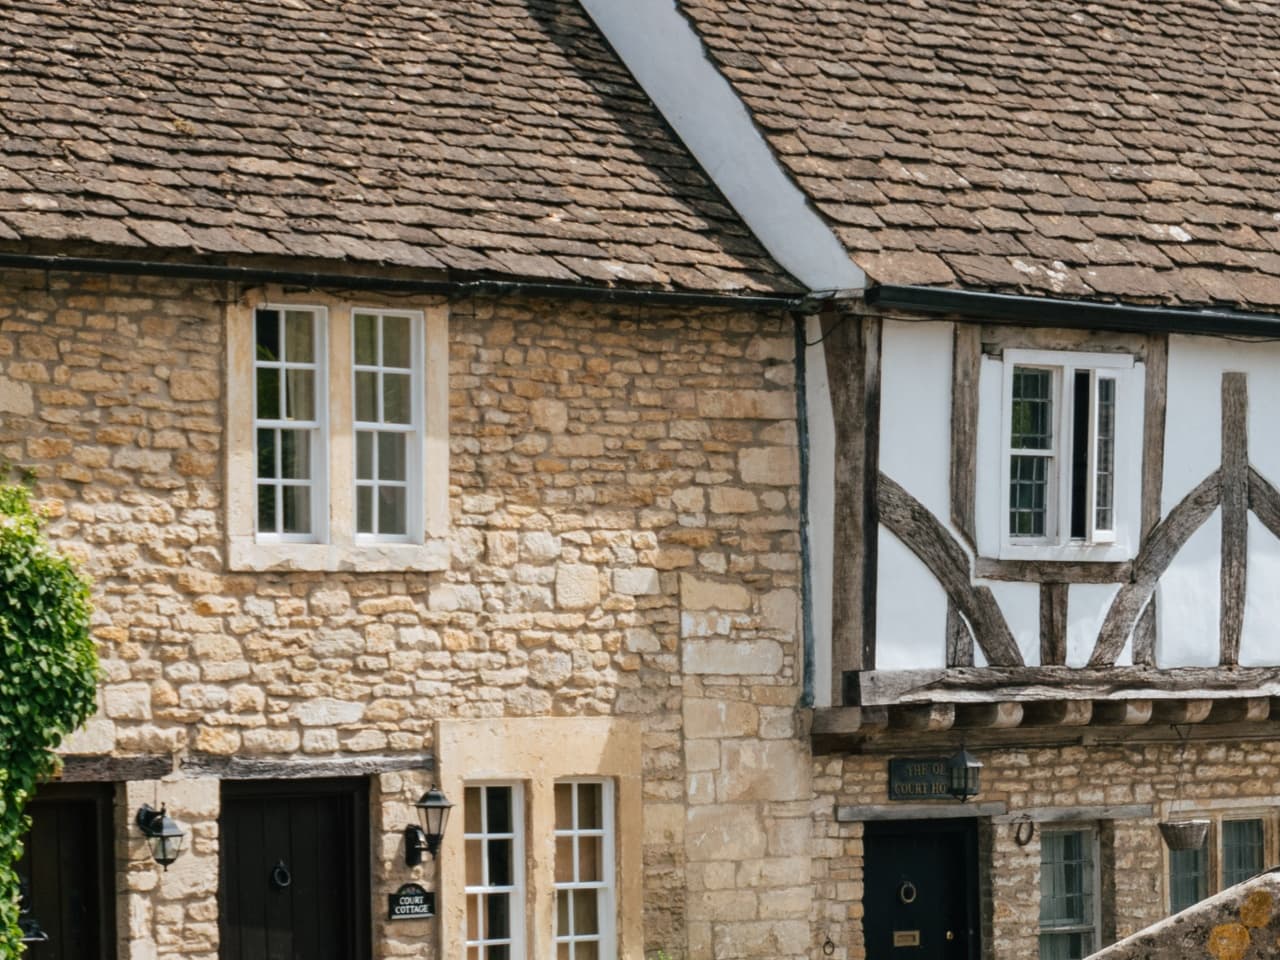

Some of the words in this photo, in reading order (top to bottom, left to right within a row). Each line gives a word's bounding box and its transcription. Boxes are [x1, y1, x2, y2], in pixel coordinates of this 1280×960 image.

[895, 783, 928, 794] COURT
[399, 896, 424, 905] COURT
[394, 904, 429, 914] COTTAGE
